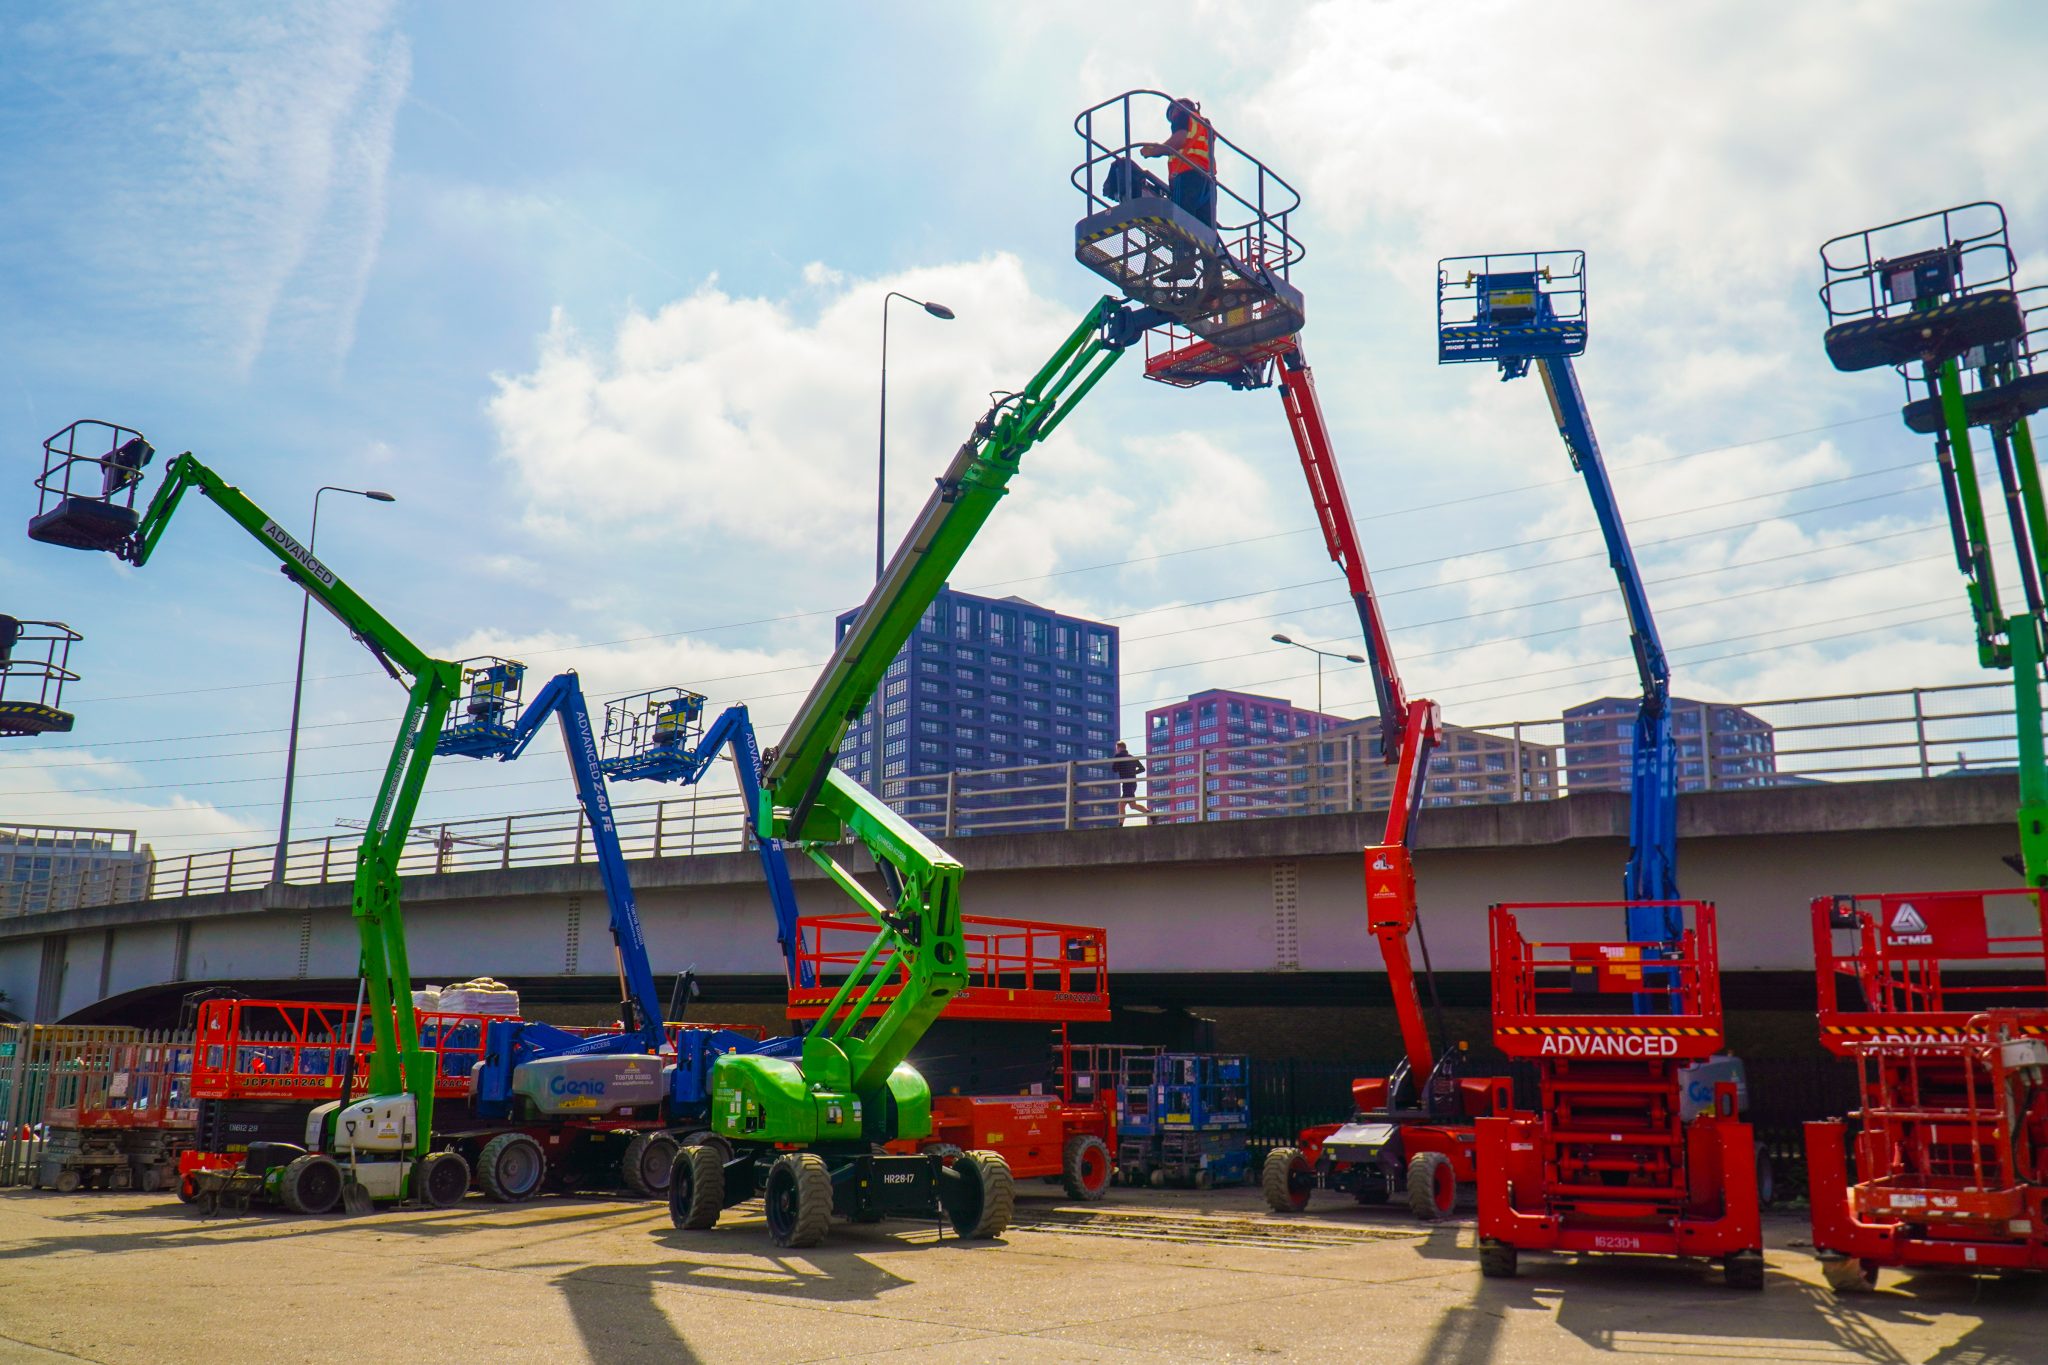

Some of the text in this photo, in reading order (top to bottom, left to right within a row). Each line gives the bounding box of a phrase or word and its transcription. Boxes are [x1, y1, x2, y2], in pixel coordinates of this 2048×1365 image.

[265, 525, 333, 584] ADVANCED
[576, 711, 613, 832] ADVANCED Z-60 FE
[561, 1040, 611, 1056] ADVANCED ACCESS
[1541, 1035, 1678, 1056] ADVANCED
[242, 1078, 325, 1087] JCPT1612AC
[551, 1075, 605, 1095] Genie
